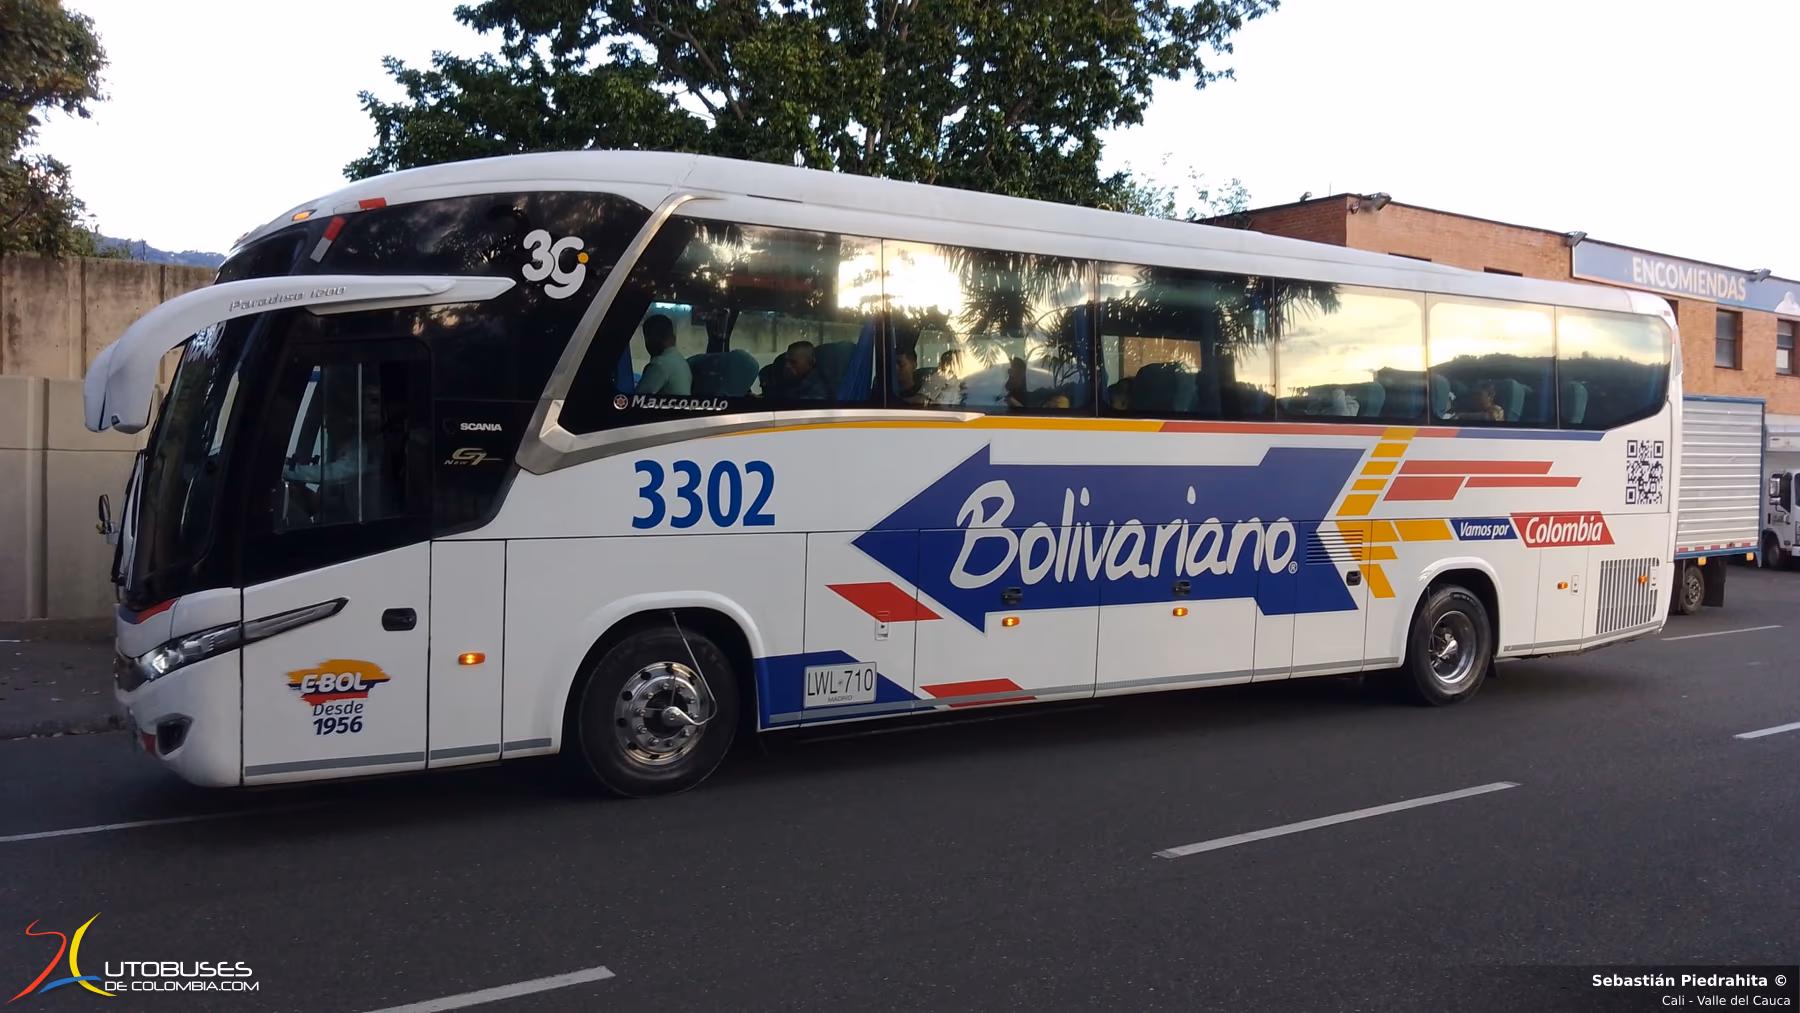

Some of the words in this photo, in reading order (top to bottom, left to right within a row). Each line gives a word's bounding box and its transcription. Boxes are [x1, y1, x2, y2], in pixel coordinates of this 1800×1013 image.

[1632, 256, 1747, 301] ENCOMIENDAS
[229, 292, 304, 311] Paradiso
[310, 286, 347, 299] 1200
[631, 394, 729, 411] Marcopolo
[460, 422, 503, 431] SCANIA
[631, 460, 776, 529] 3302
[950, 480, 1296, 589] Bolivariano
[1460, 522, 1491, 537] Vamos
[1491, 523, 1510, 540] por
[1525, 515, 1604, 544] Colombia
[312, 700, 364, 716] Desde
[312, 716, 363, 735] 1956
